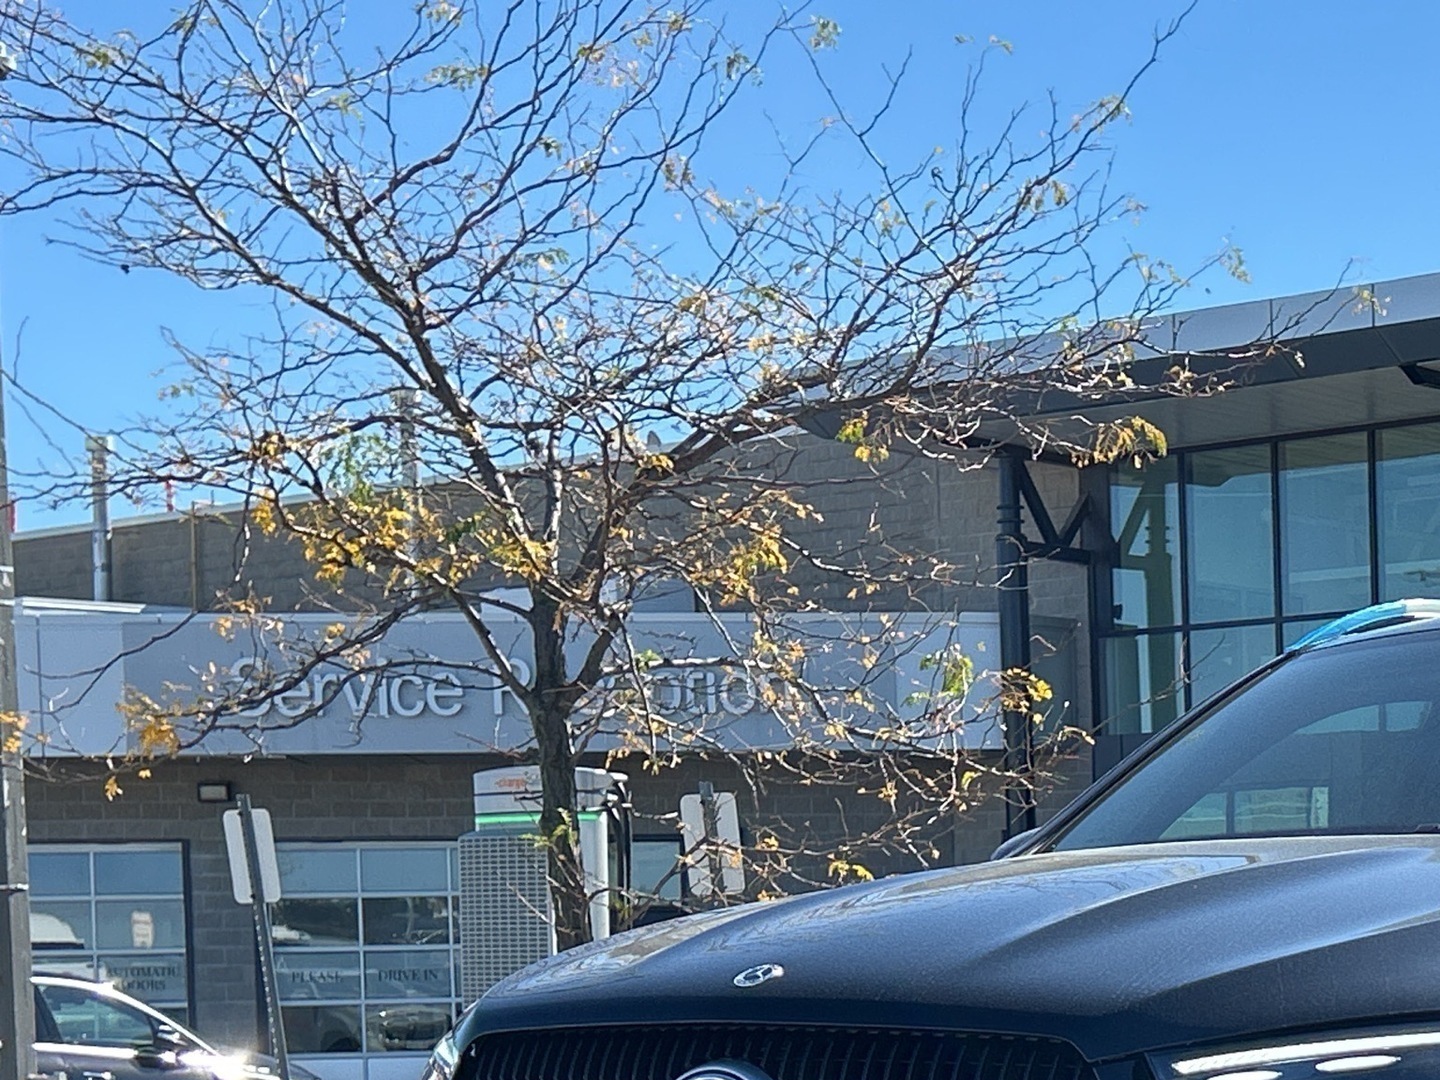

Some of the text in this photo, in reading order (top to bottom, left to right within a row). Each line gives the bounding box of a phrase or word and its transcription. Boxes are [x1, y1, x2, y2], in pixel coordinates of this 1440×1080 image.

[229, 656, 464, 718] Service
[291, 968, 439, 984] PLEASE DRIVE IN
